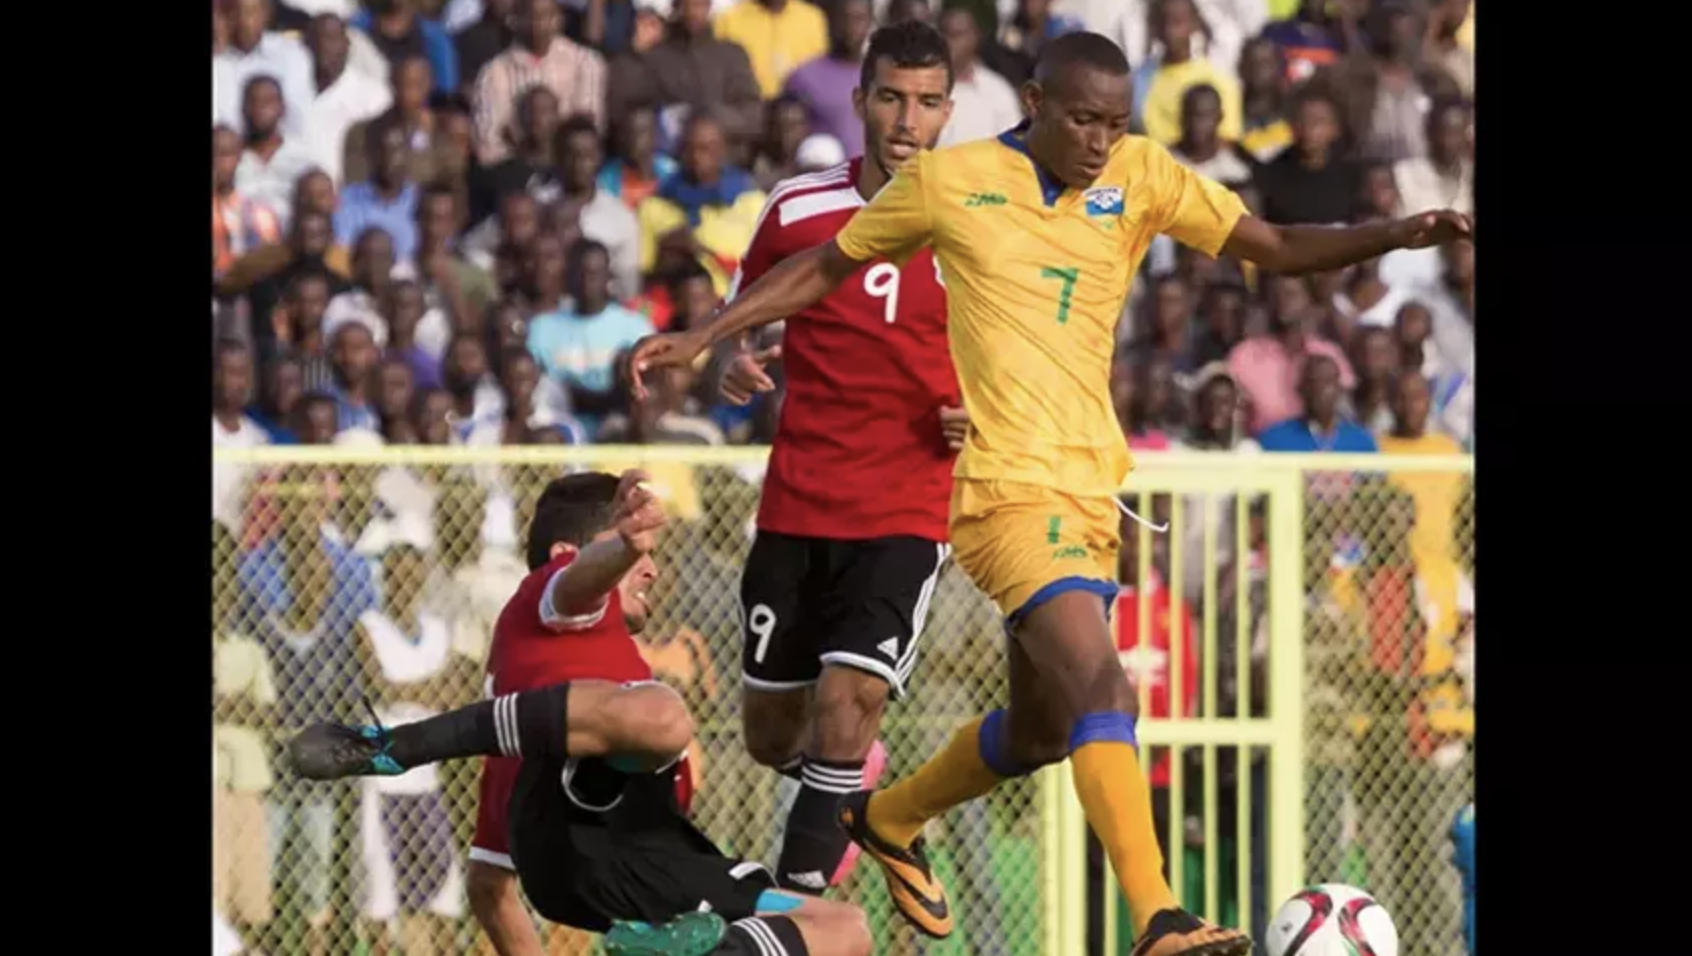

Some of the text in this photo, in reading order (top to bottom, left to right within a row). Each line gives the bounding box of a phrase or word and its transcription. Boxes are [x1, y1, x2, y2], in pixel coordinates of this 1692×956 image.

[864, 262, 900, 323] 9
[1041, 266, 1078, 325] 7
[749, 603, 776, 664] 9
